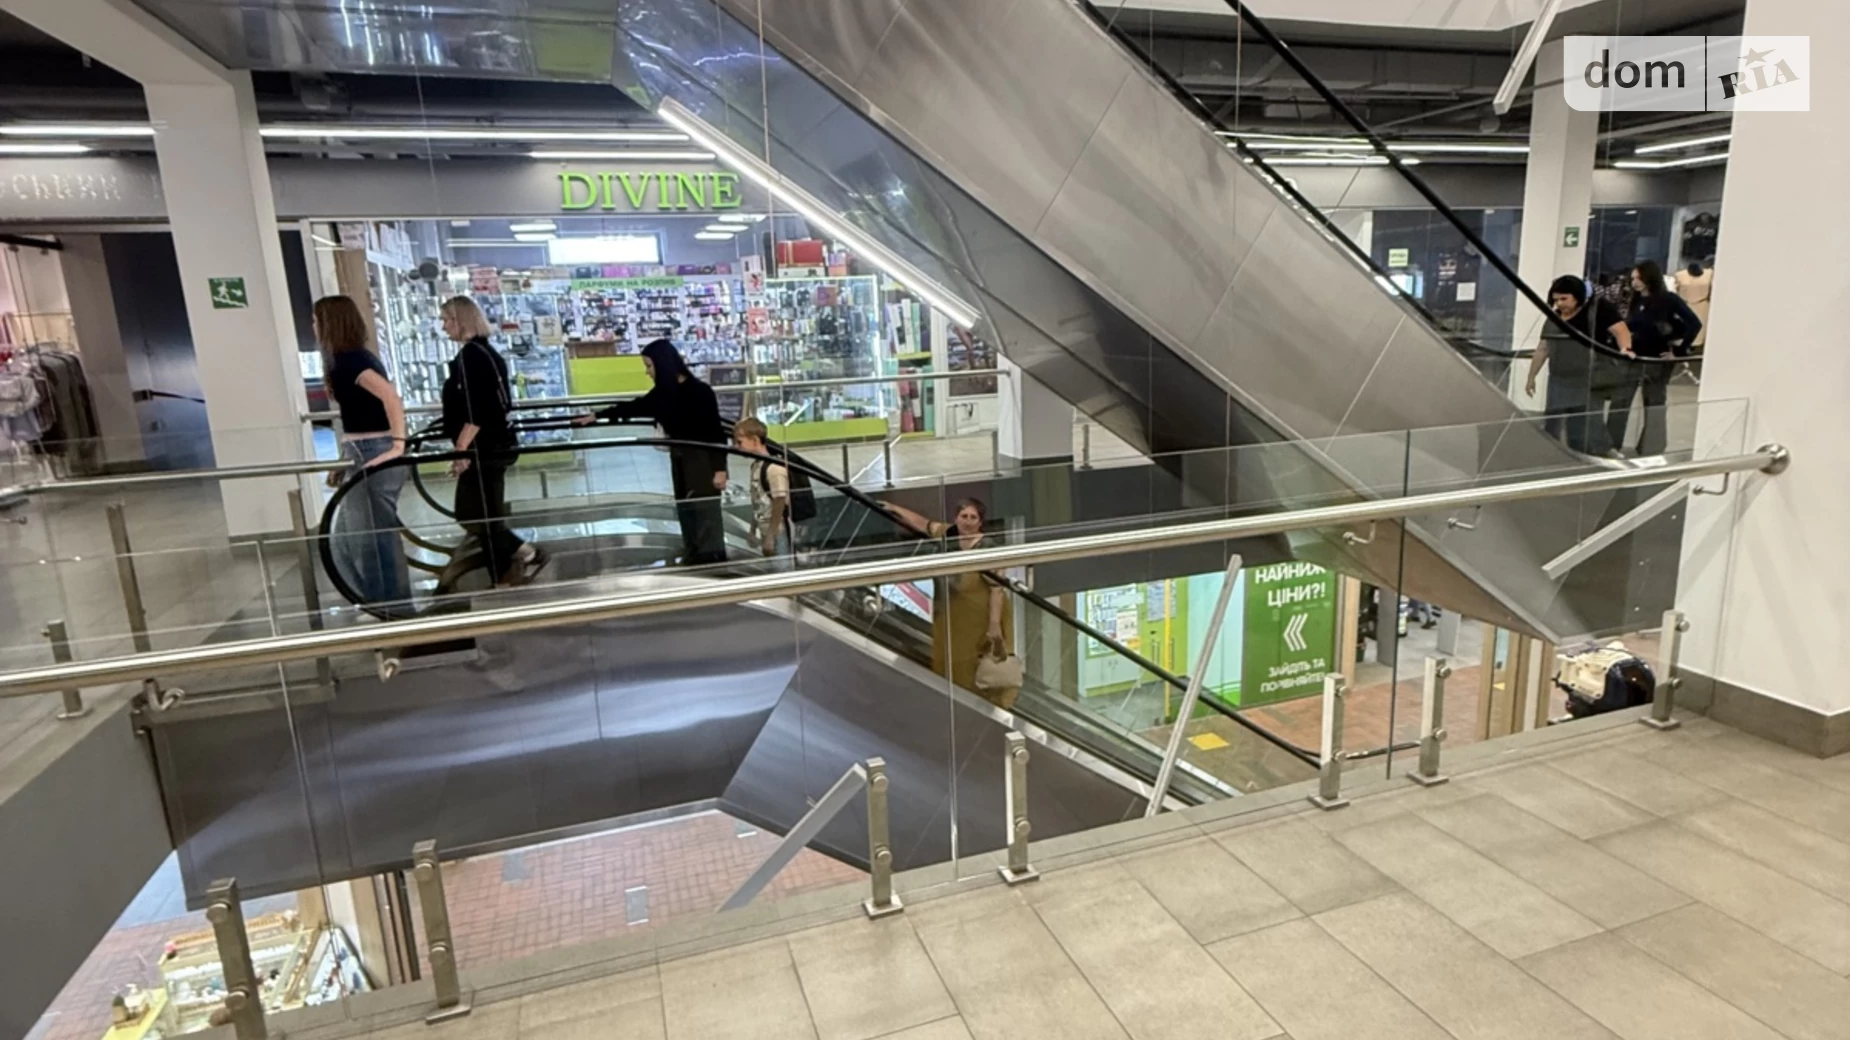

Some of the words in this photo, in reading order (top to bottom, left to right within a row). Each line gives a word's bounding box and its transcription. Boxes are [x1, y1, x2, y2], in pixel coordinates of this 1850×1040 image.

[558, 171, 742, 210] DIVINE
[1268, 582, 1326, 608] ЦІНИ?!
[1312, 658, 1326, 669] ТА
